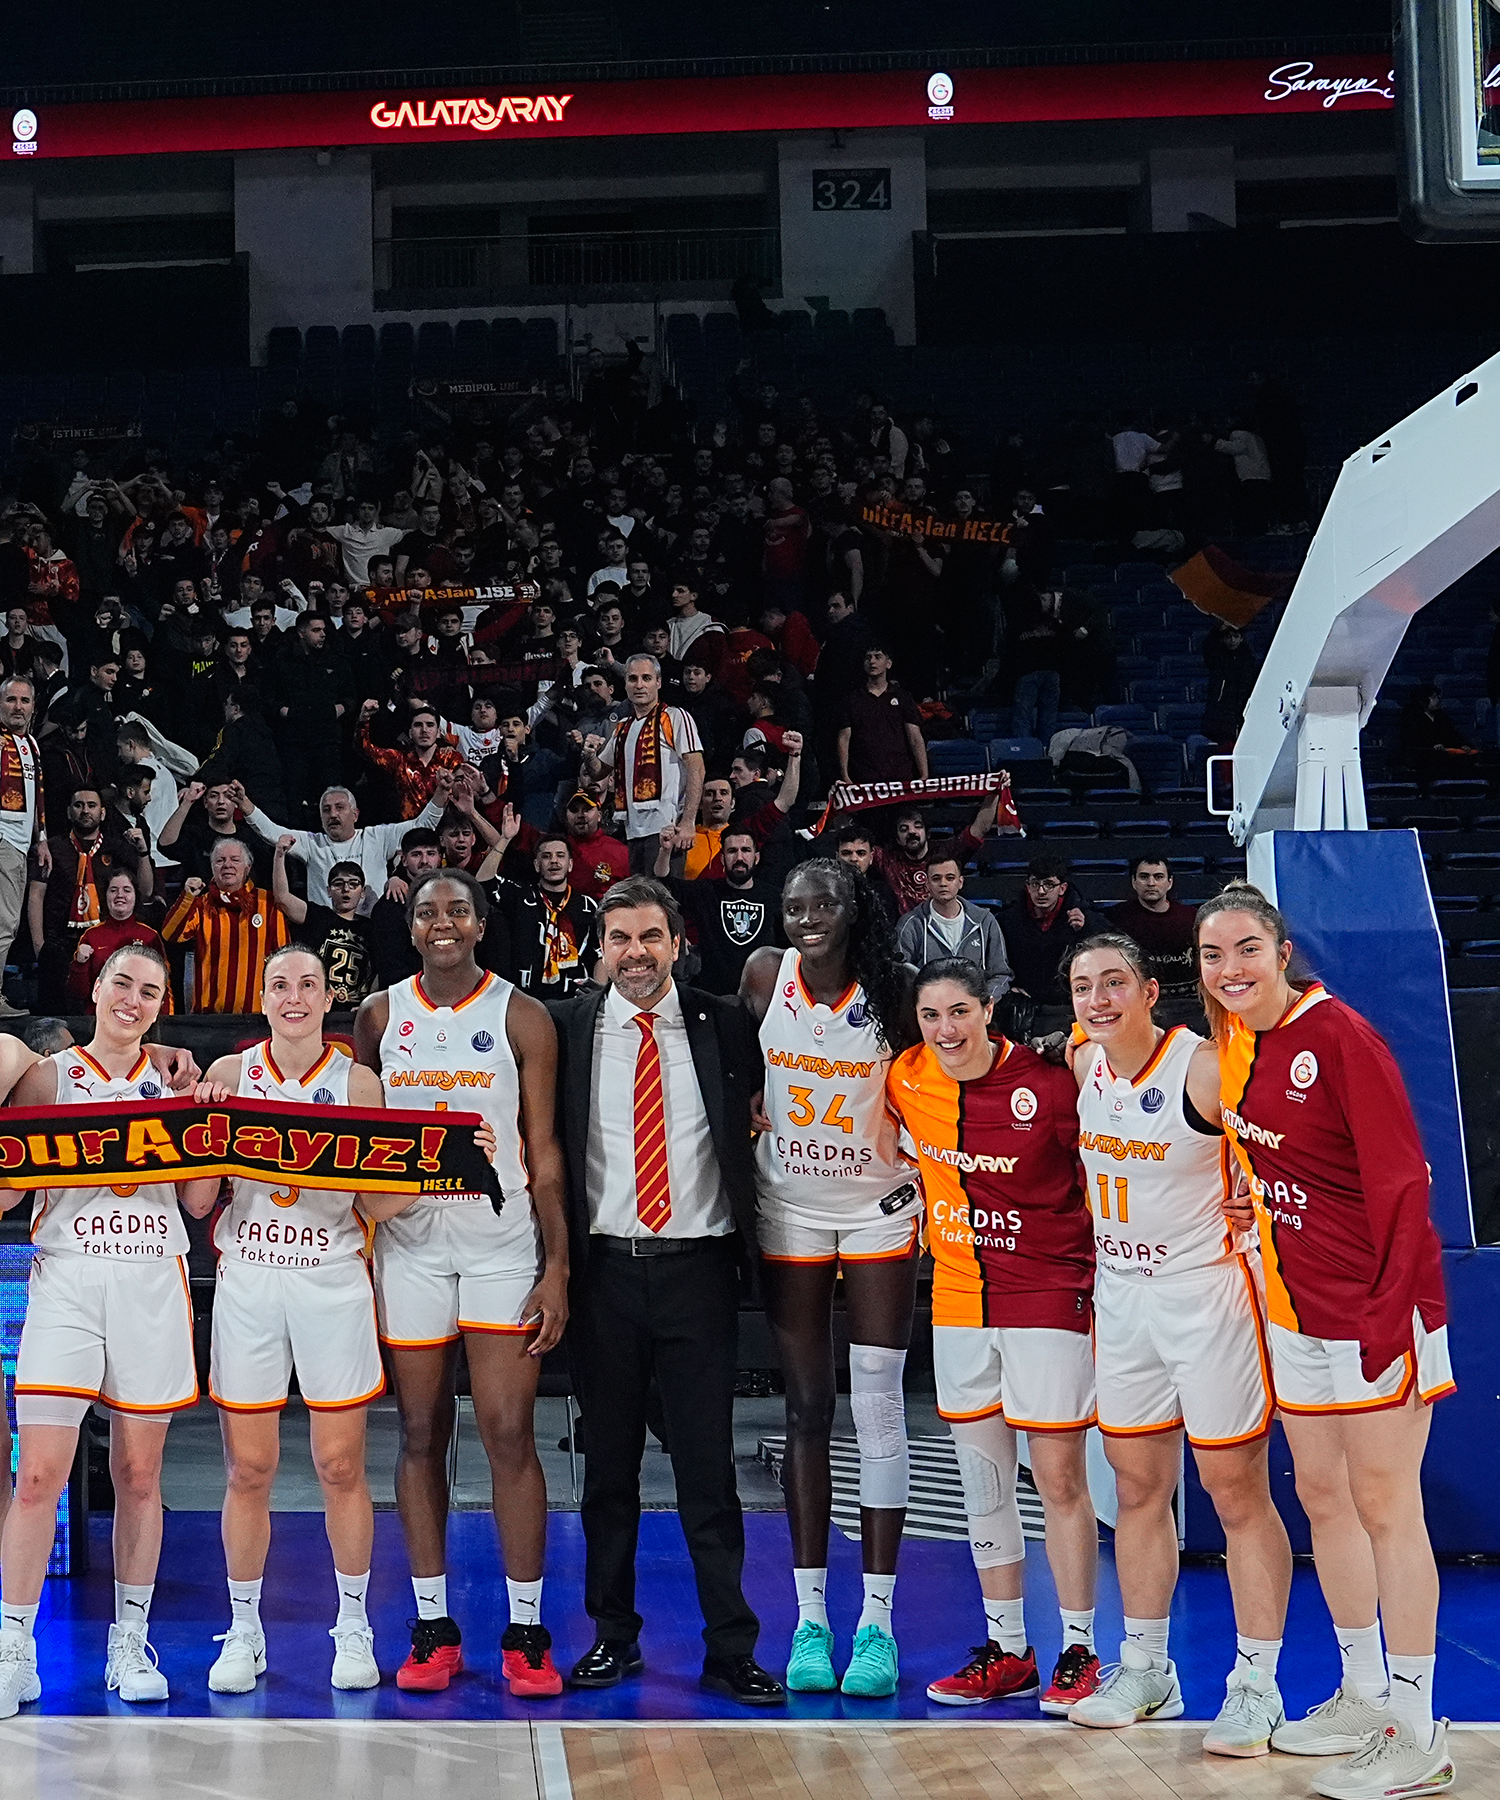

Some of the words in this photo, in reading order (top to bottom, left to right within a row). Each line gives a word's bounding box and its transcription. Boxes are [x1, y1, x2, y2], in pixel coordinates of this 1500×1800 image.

[371, 95, 574, 131] GALATASARAY
[817, 180, 888, 210] 324
[963, 520, 1015, 544] HELL
[910, 772, 1000, 794] OSIMHE
[726, 904, 760, 912] RAIDERS
[328, 946, 364, 985] 25
[767, 1047, 877, 1080] GALATASARAY
[389, 1070, 496, 1092] GALATASARAY
[787, 1084, 854, 1135] 34
[776, 1135, 873, 1166] ÇAĞDAŞ
[919, 1140, 1020, 1174] GALATASARAY
[423, 1177, 466, 1192] HELL
[784, 1162, 863, 1178] faktoring
[1096, 1173, 1130, 1224] 11
[73, 1210, 168, 1240] ÇAĞDAŞ
[236, 1219, 330, 1253] ÇAĞDAŞ
[939, 1226, 1017, 1252] faktoring
[83, 1240, 164, 1258] faktoring
